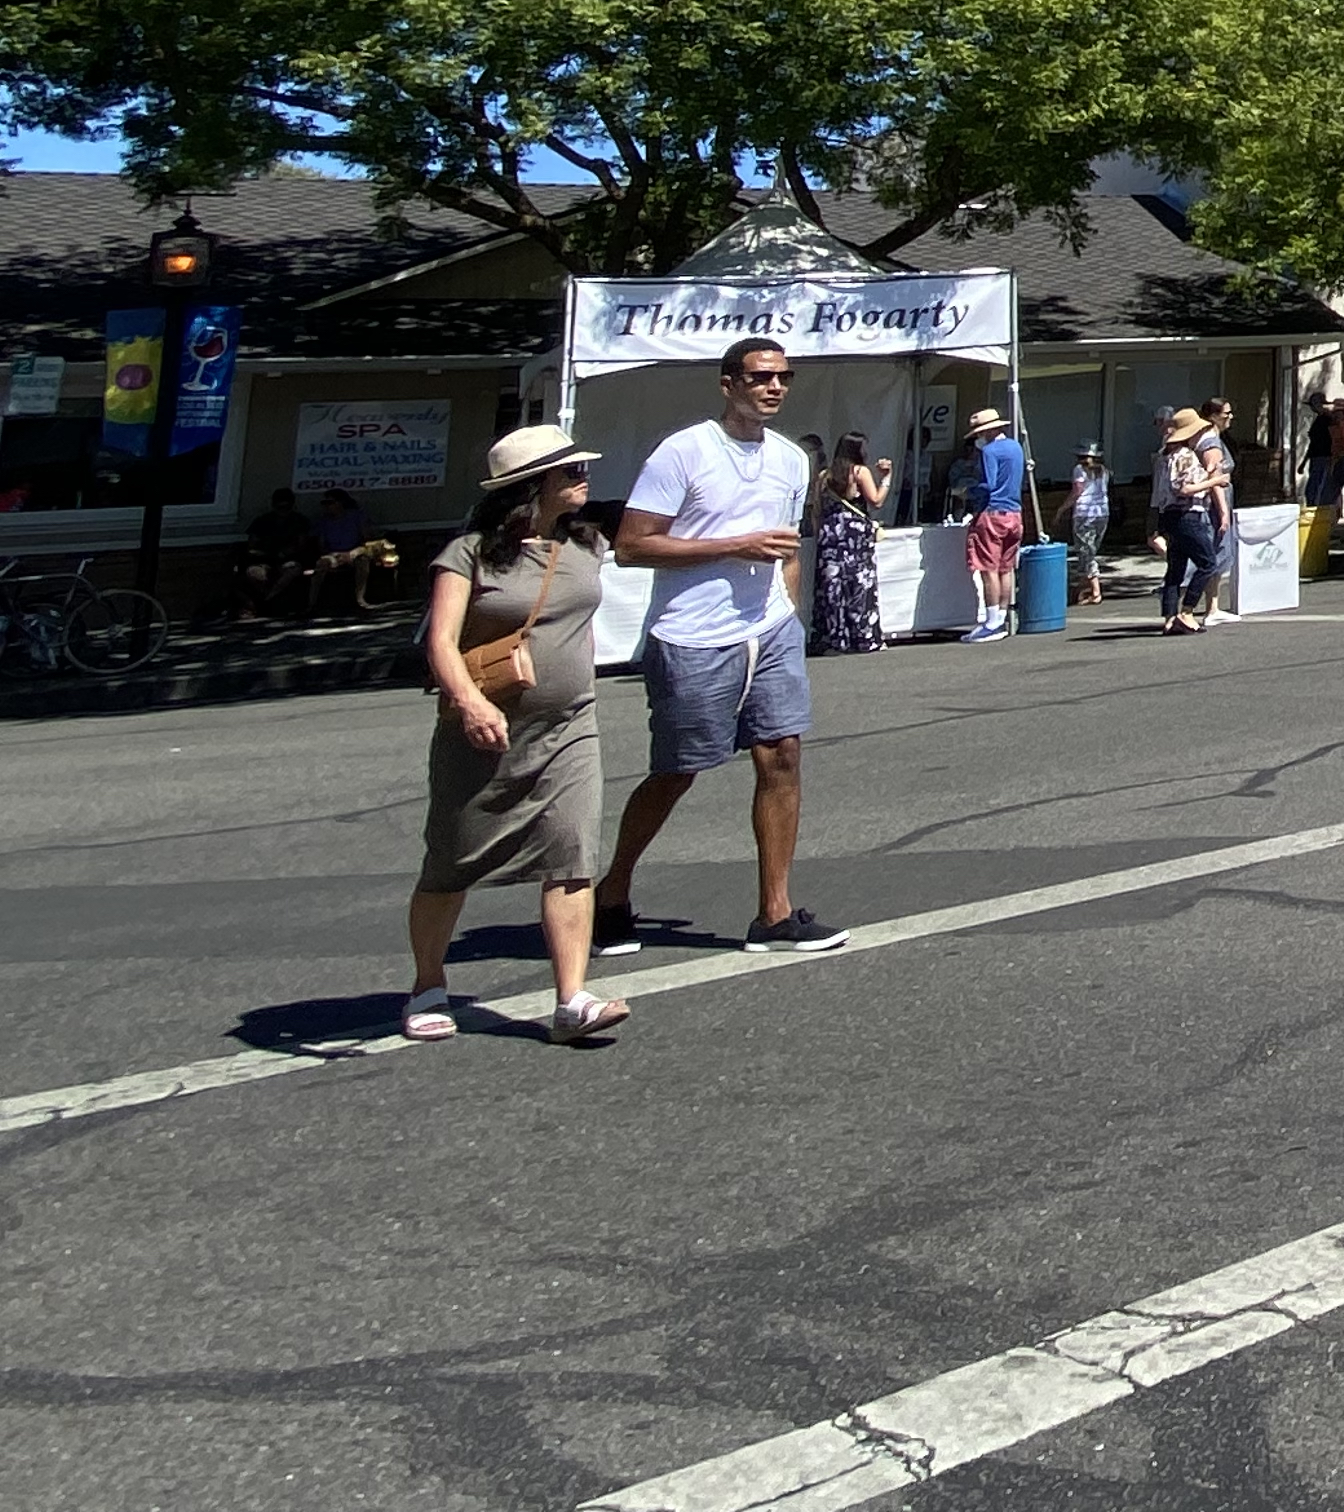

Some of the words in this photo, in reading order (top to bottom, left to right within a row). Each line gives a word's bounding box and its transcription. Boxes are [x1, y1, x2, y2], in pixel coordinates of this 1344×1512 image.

[615, 303, 796, 337] Thomas
[808, 297, 971, 342] Fogarty
[336, 423, 408, 439] SPA
[383, 439, 438, 451] NAILS
